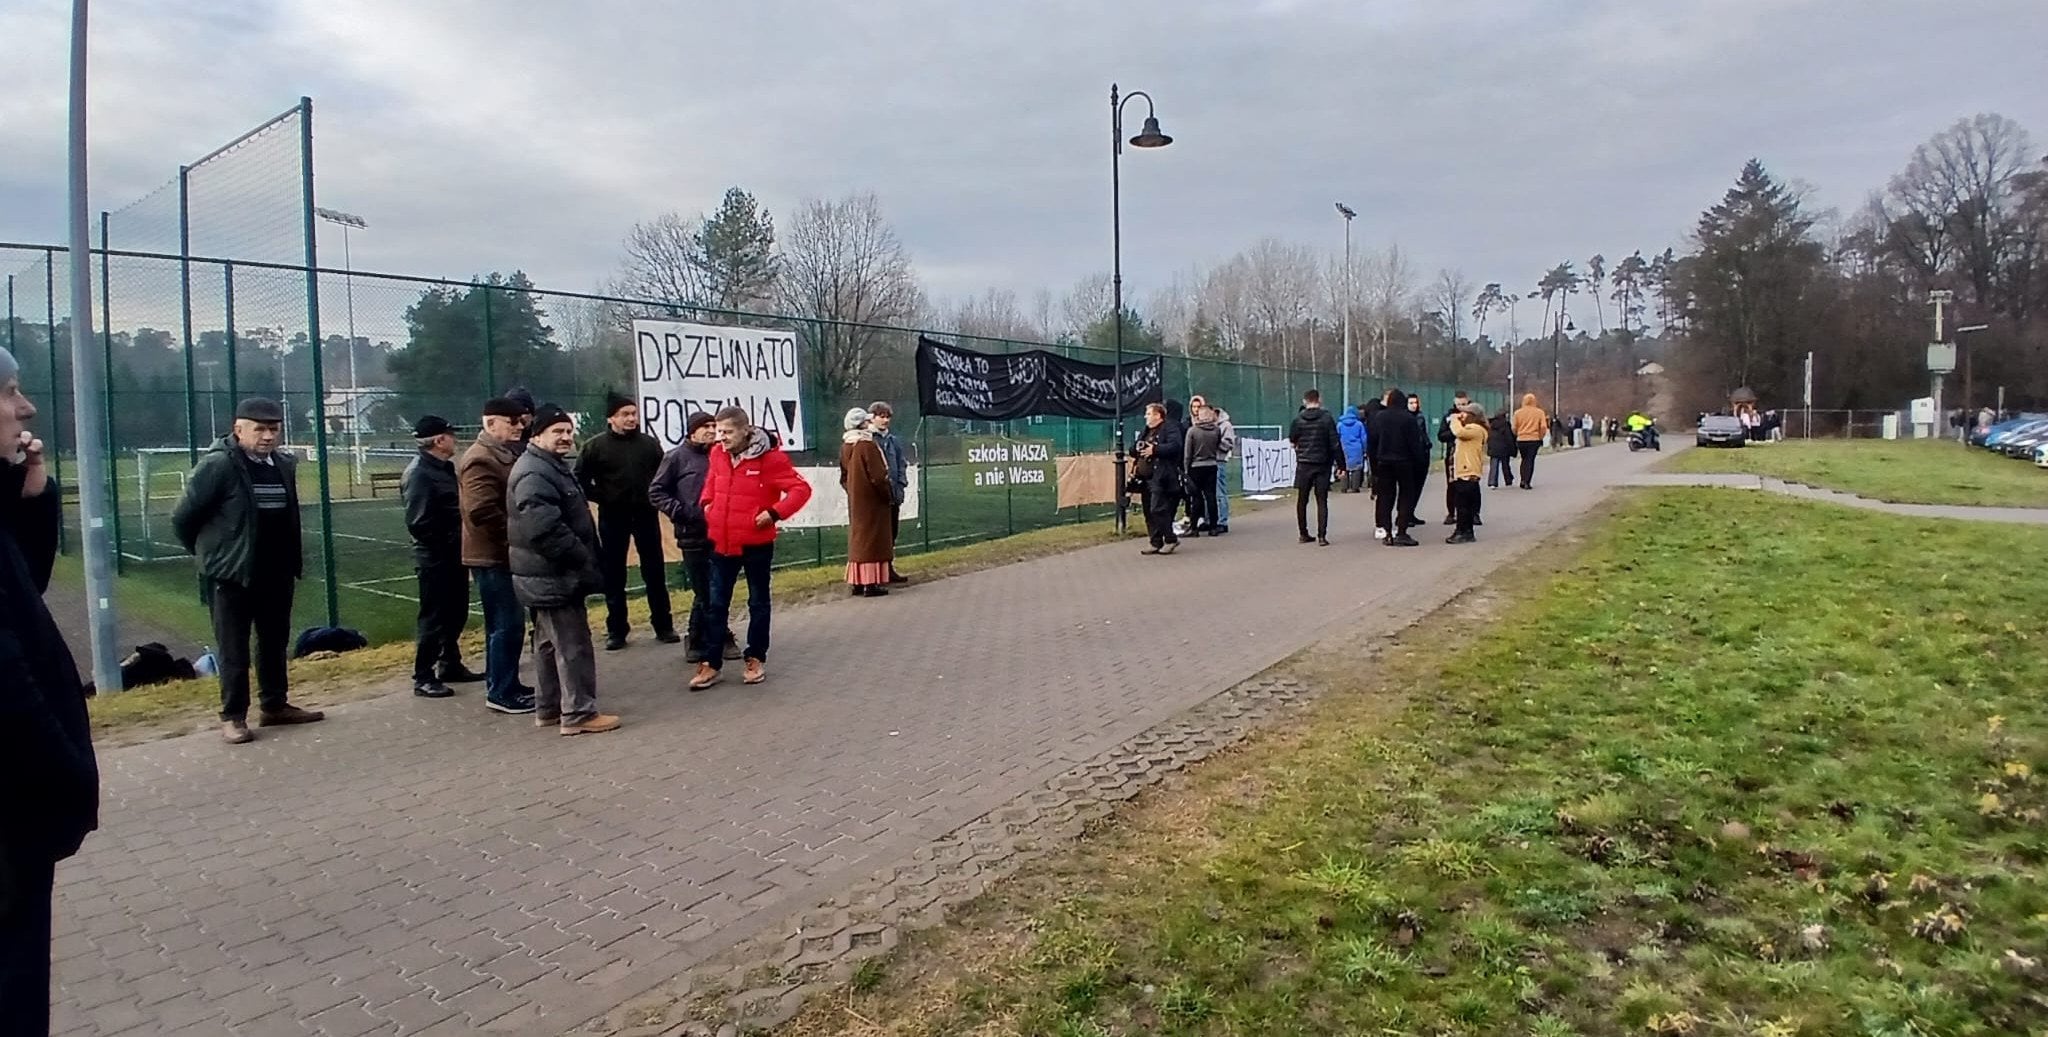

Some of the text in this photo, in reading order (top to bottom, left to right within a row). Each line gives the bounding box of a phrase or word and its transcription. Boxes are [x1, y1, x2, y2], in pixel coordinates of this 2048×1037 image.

[974, 357, 989, 374] TO
[1012, 444, 1048, 461] NASZA
[1245, 446, 1296, 483] #DRZE
[975, 467, 1044, 486] a nie Wasza
